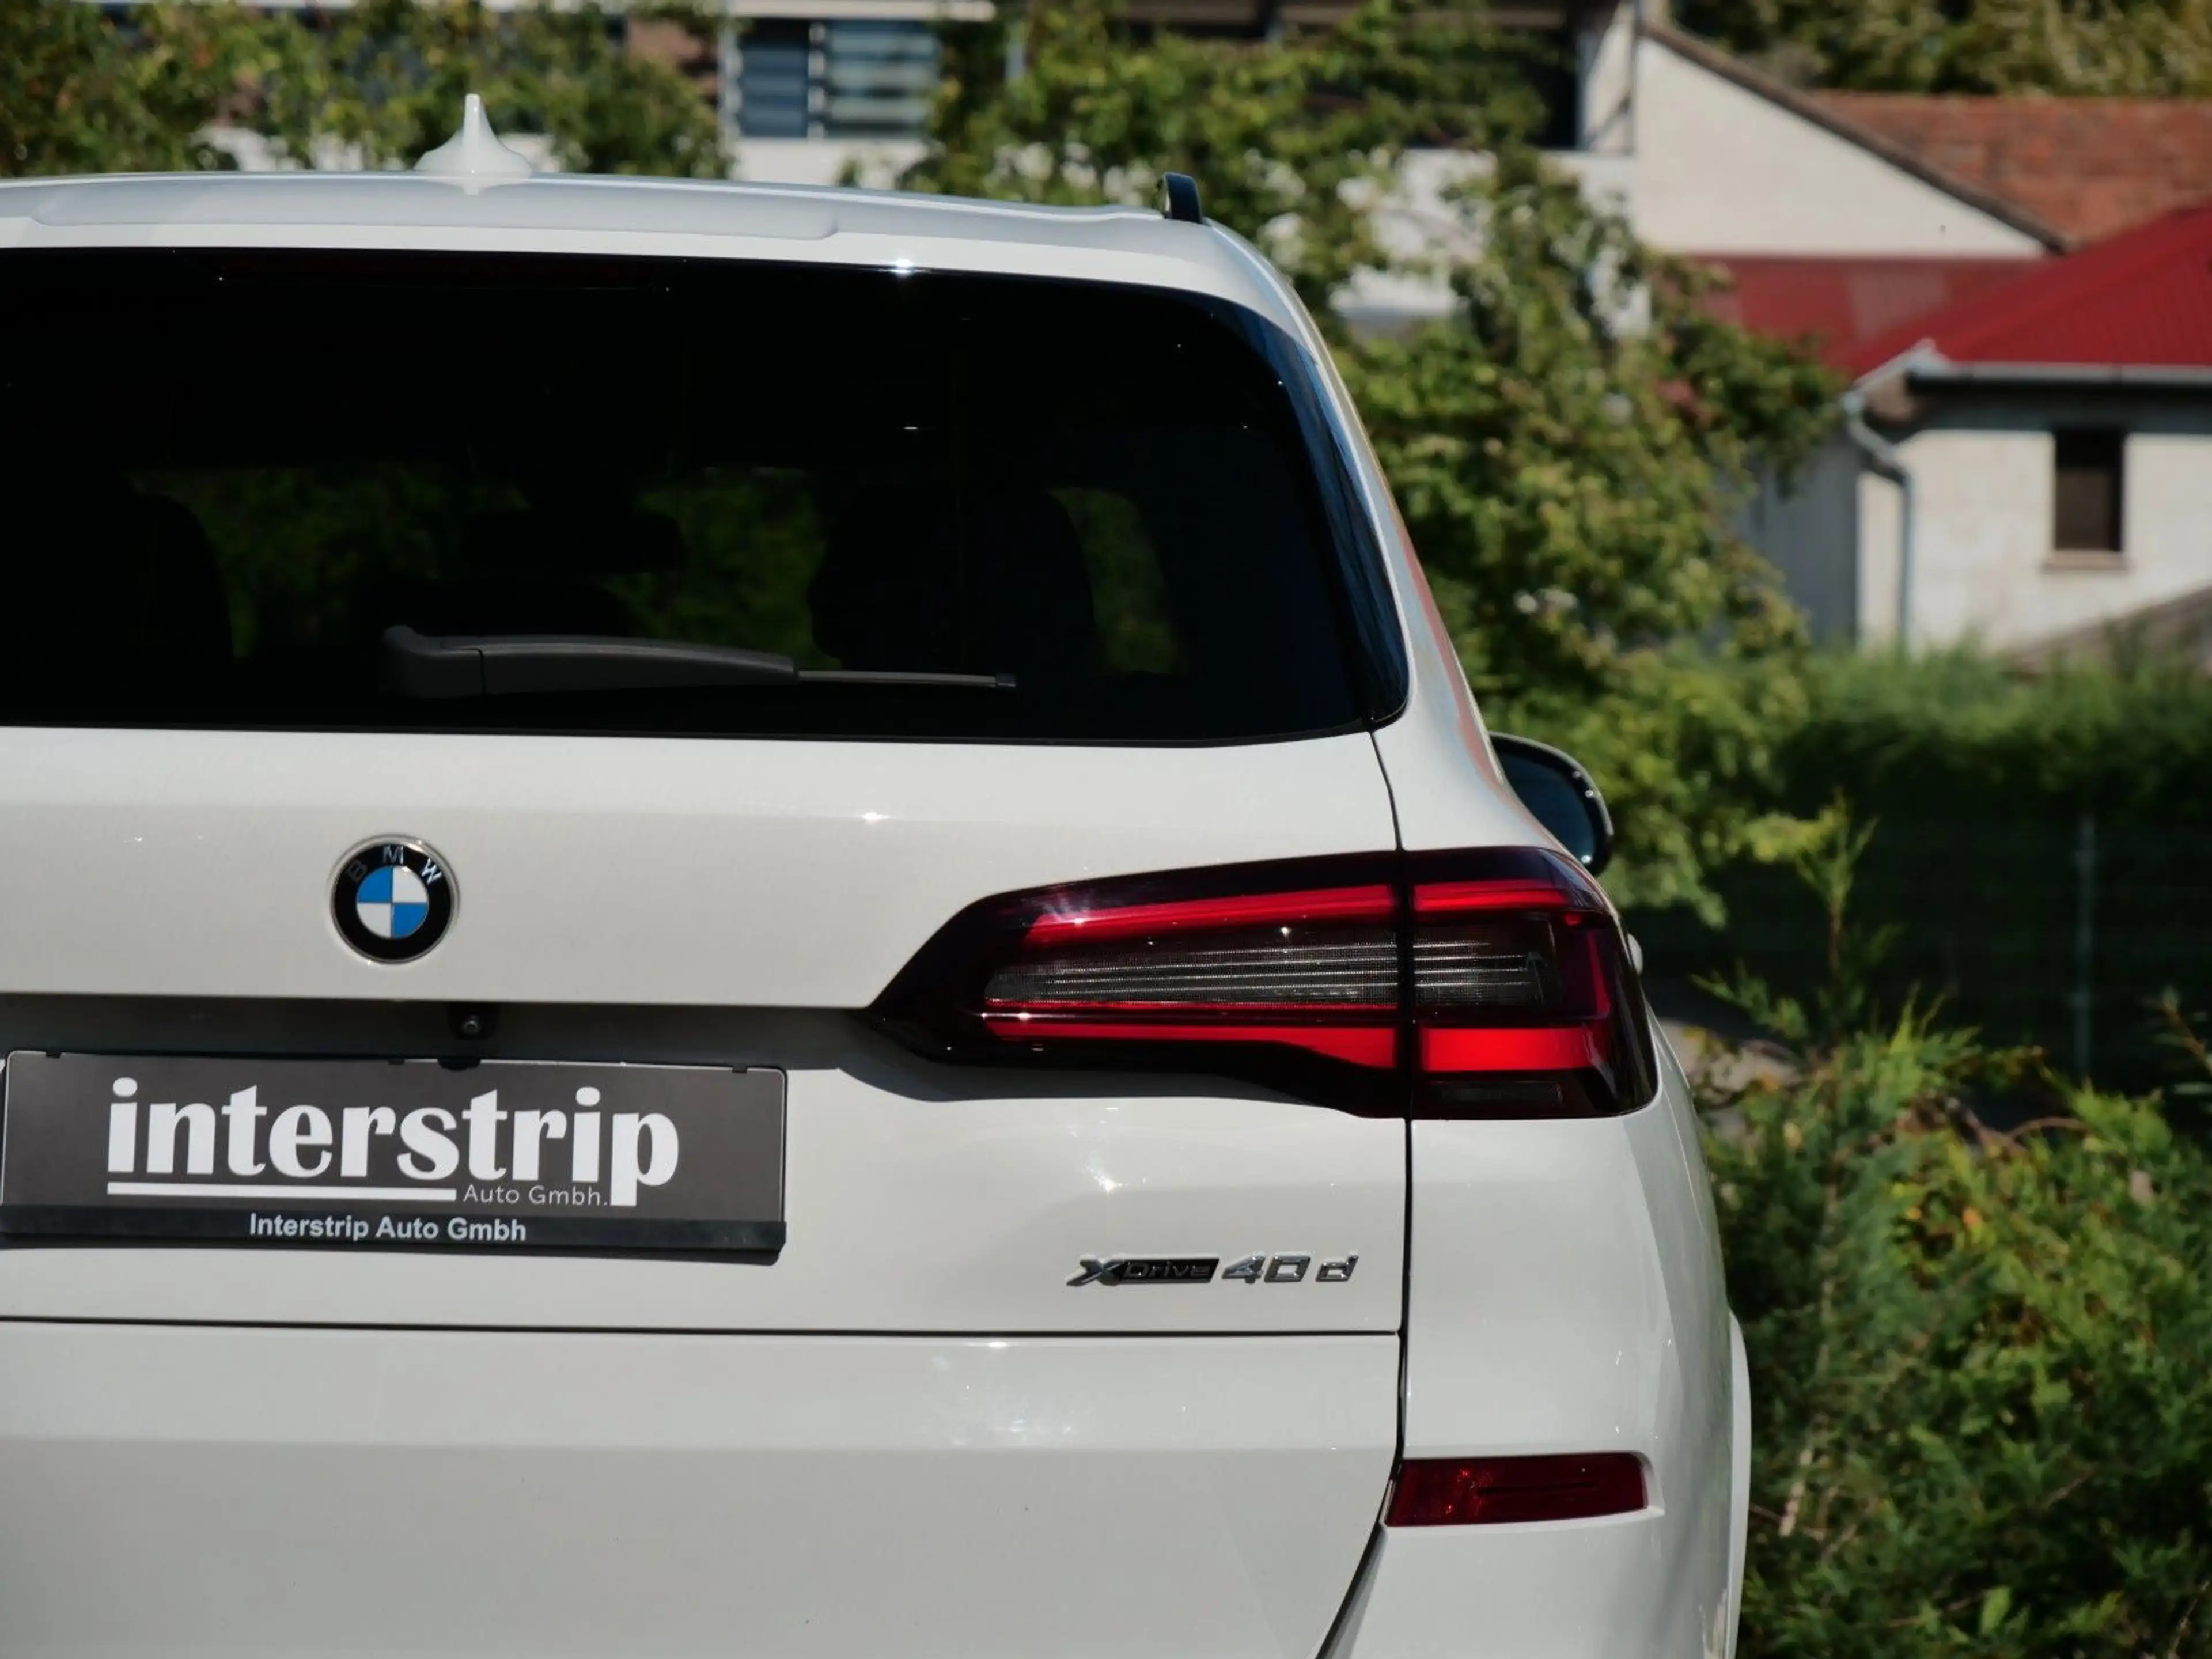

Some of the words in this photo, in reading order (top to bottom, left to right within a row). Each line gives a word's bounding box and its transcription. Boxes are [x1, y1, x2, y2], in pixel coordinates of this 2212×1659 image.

[346, 844, 443, 885] BMW
[107, 1077, 679, 1207] interstrip
[463, 1184, 520, 1204] Auto
[249, 1213, 369, 1241] Interstrip
[376, 1216, 440, 1239] Auto
[447, 1217, 527, 1241] Gmbh
